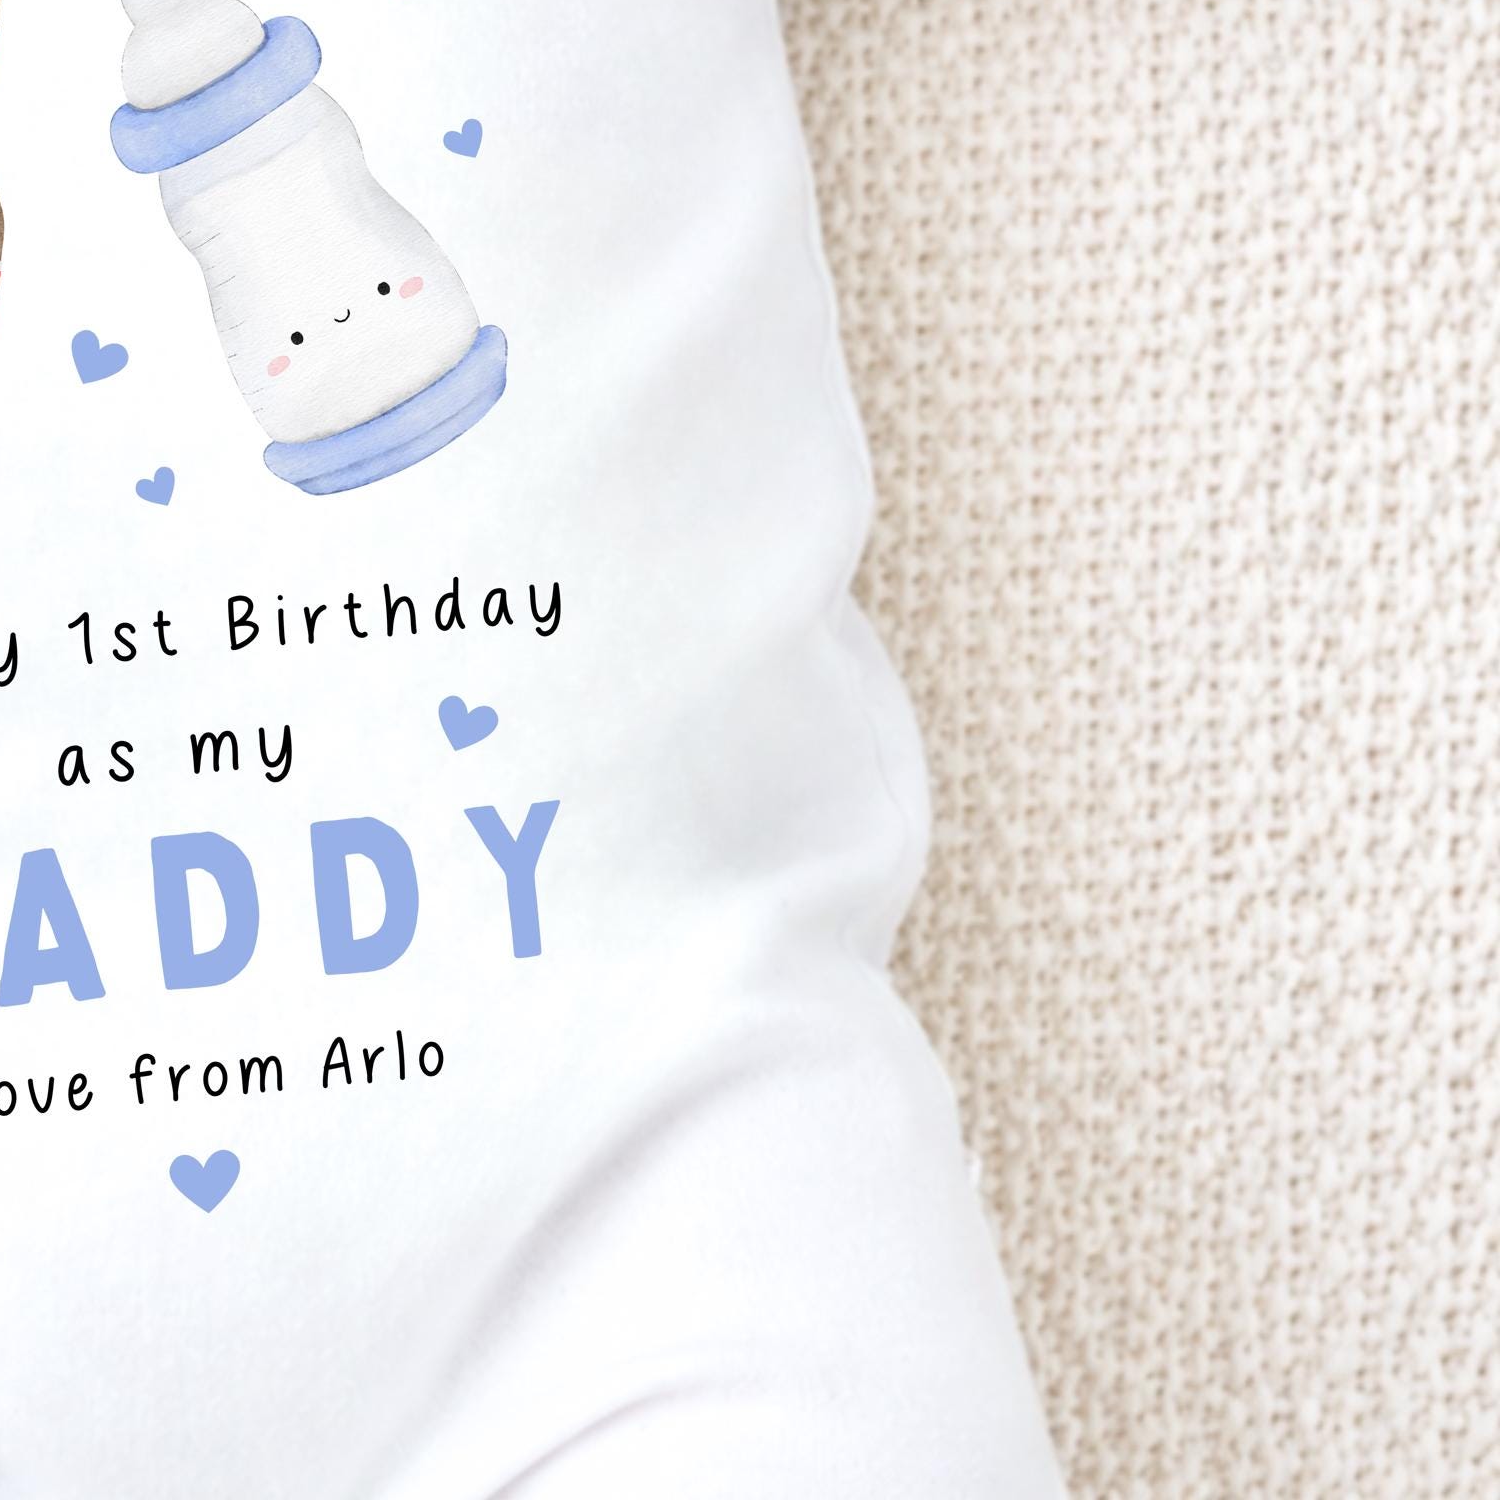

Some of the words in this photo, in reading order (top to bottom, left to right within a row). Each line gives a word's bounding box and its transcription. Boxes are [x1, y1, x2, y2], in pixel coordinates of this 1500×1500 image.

[67, 609, 178, 665] 1st
[227, 576, 562, 651] Birthday
[57, 740, 135, 787] as
[189, 724, 293, 783] my
[128, 1053, 284, 1105] from
[322, 1029, 444, 1089] Arlo
